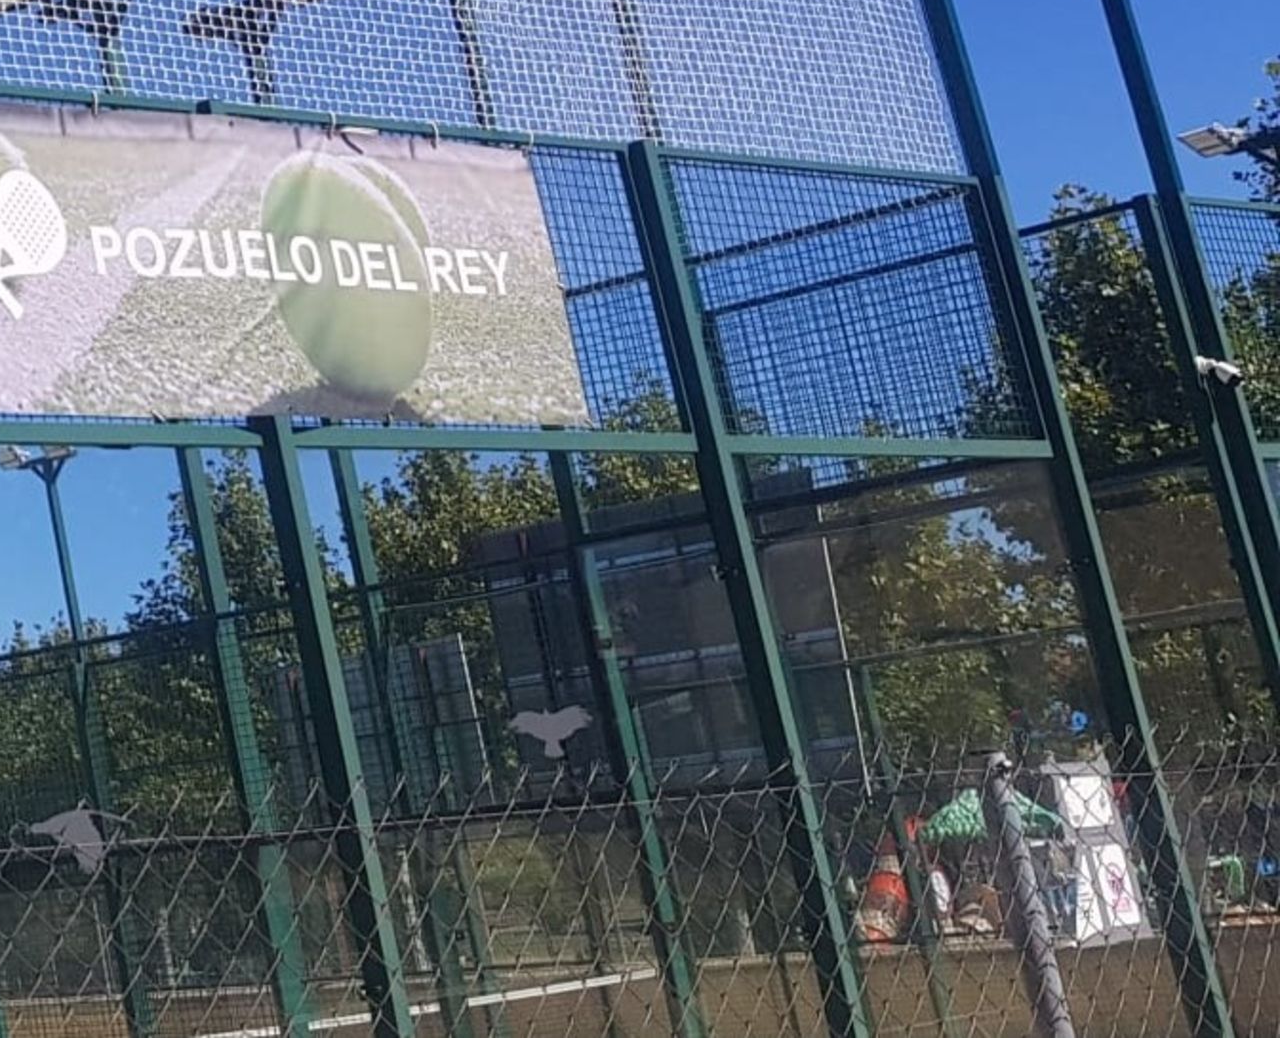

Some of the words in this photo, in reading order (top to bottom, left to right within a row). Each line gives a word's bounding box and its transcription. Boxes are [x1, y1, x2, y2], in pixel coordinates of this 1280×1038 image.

[93, 226, 322, 283] POZUELO
[336, 239, 419, 291] DEL
[426, 246, 510, 296] REY
